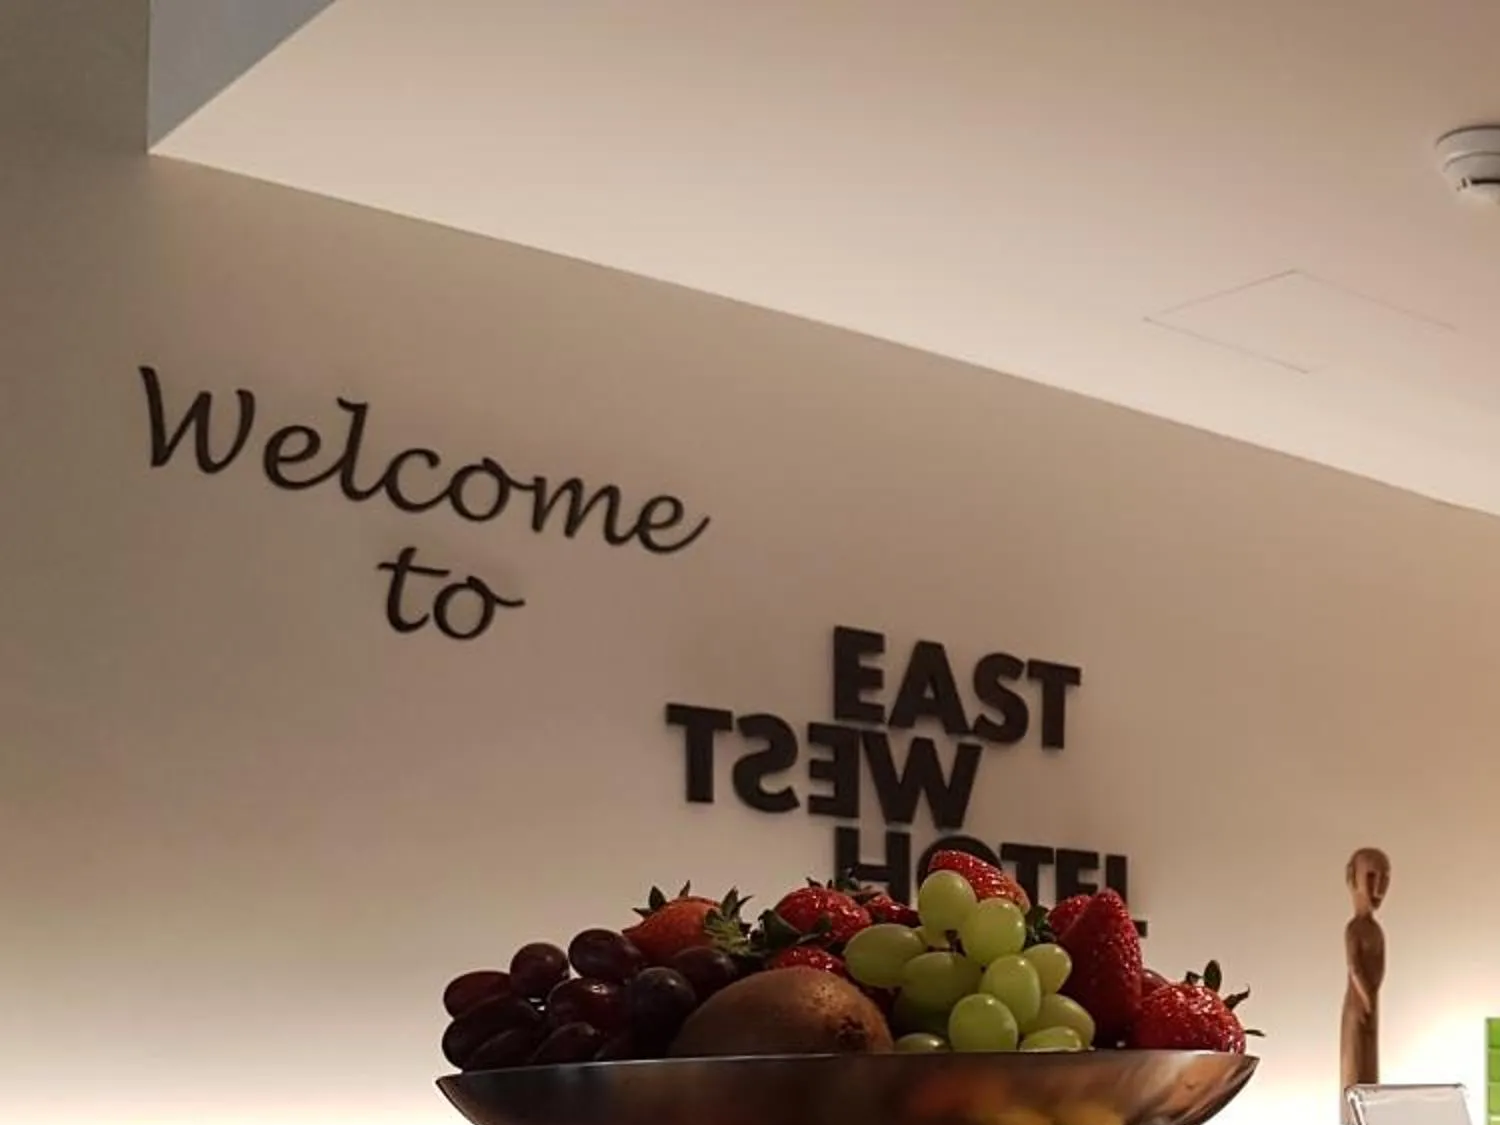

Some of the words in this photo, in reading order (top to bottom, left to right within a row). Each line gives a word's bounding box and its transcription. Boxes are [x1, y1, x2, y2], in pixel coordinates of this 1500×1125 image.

[138, 366, 710, 554] Welcome
[377, 546, 526, 641] to
[833, 625, 1083, 750] EAST
